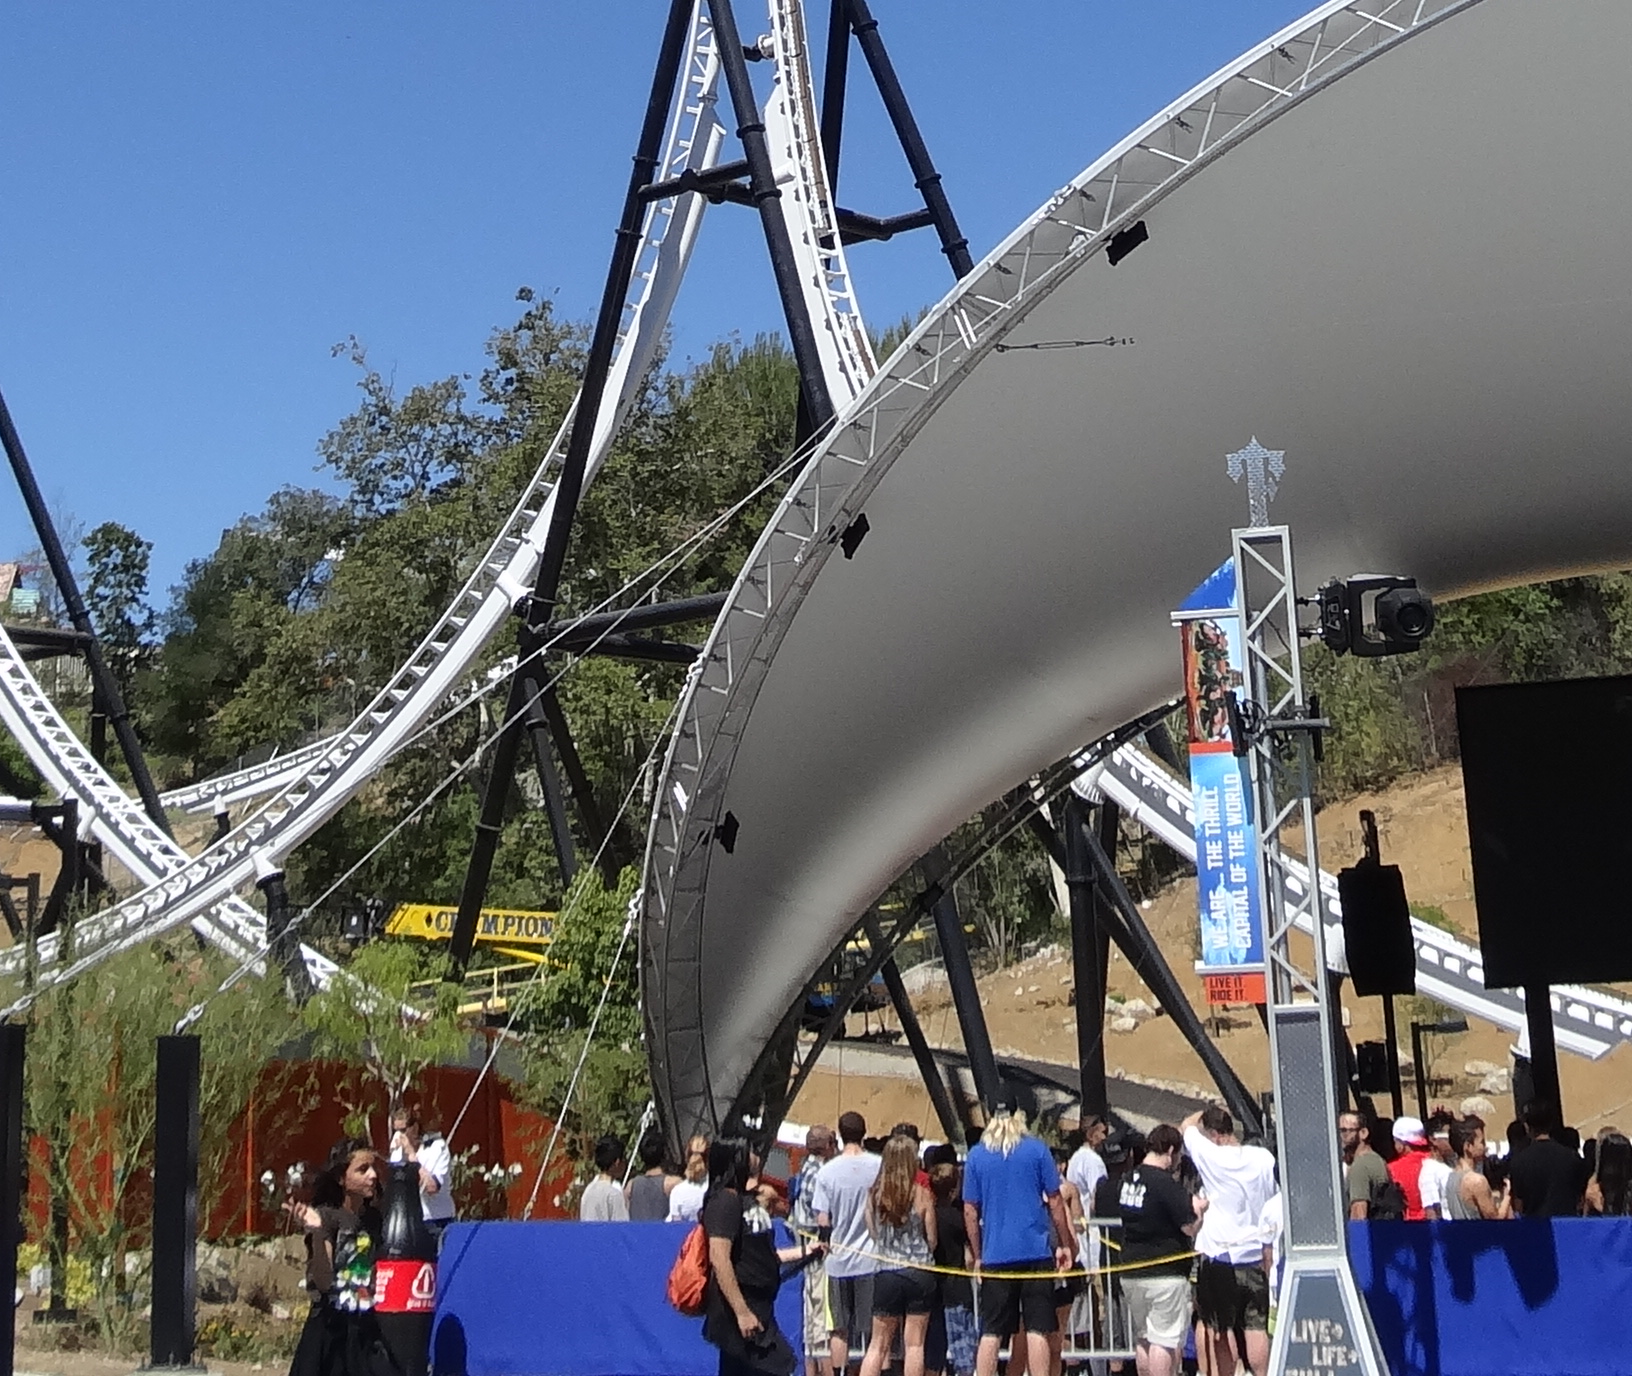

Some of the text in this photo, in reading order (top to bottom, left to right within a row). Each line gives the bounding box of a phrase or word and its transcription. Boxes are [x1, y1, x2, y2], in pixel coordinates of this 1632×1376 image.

[1201, 785, 1221, 838] THRILL
[1205, 839, 1223, 871] THE
[1224, 773, 1252, 949] CAPITAL OF THE WORLD
[1211, 922, 1229, 950] WE
[1209, 976, 1232, 989] LIVE
[1210, 989, 1233, 1001] RIDE
